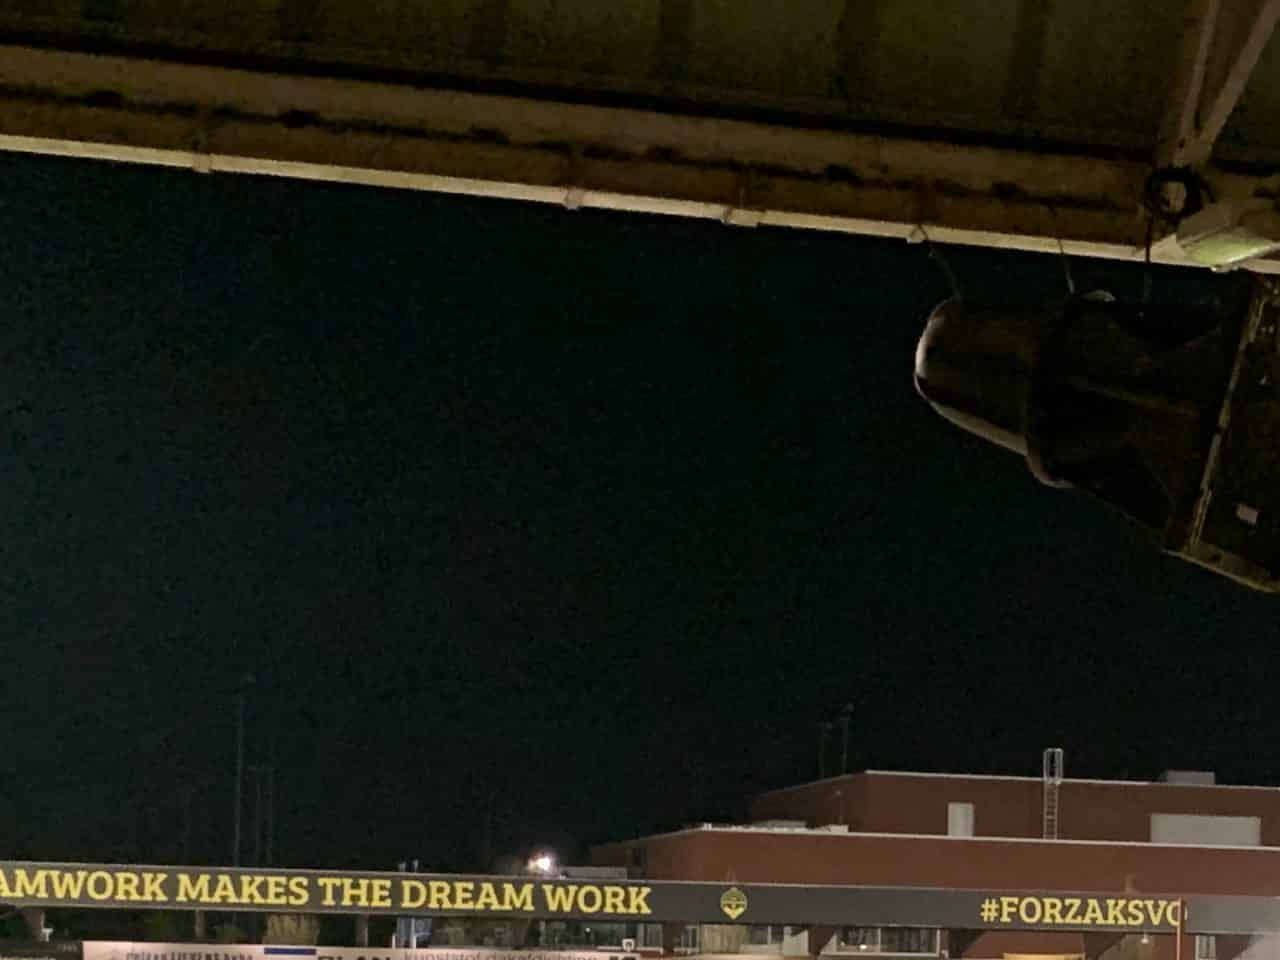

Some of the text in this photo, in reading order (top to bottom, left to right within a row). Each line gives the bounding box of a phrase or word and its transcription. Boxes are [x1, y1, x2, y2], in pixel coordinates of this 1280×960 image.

[176, 873, 310, 905] MAKES
[318, 877, 392, 908] THE
[401, 879, 535, 911] DREAM
[542, 883, 652, 915] WORK
[980, 896, 1188, 927] #FORZAKSVO
